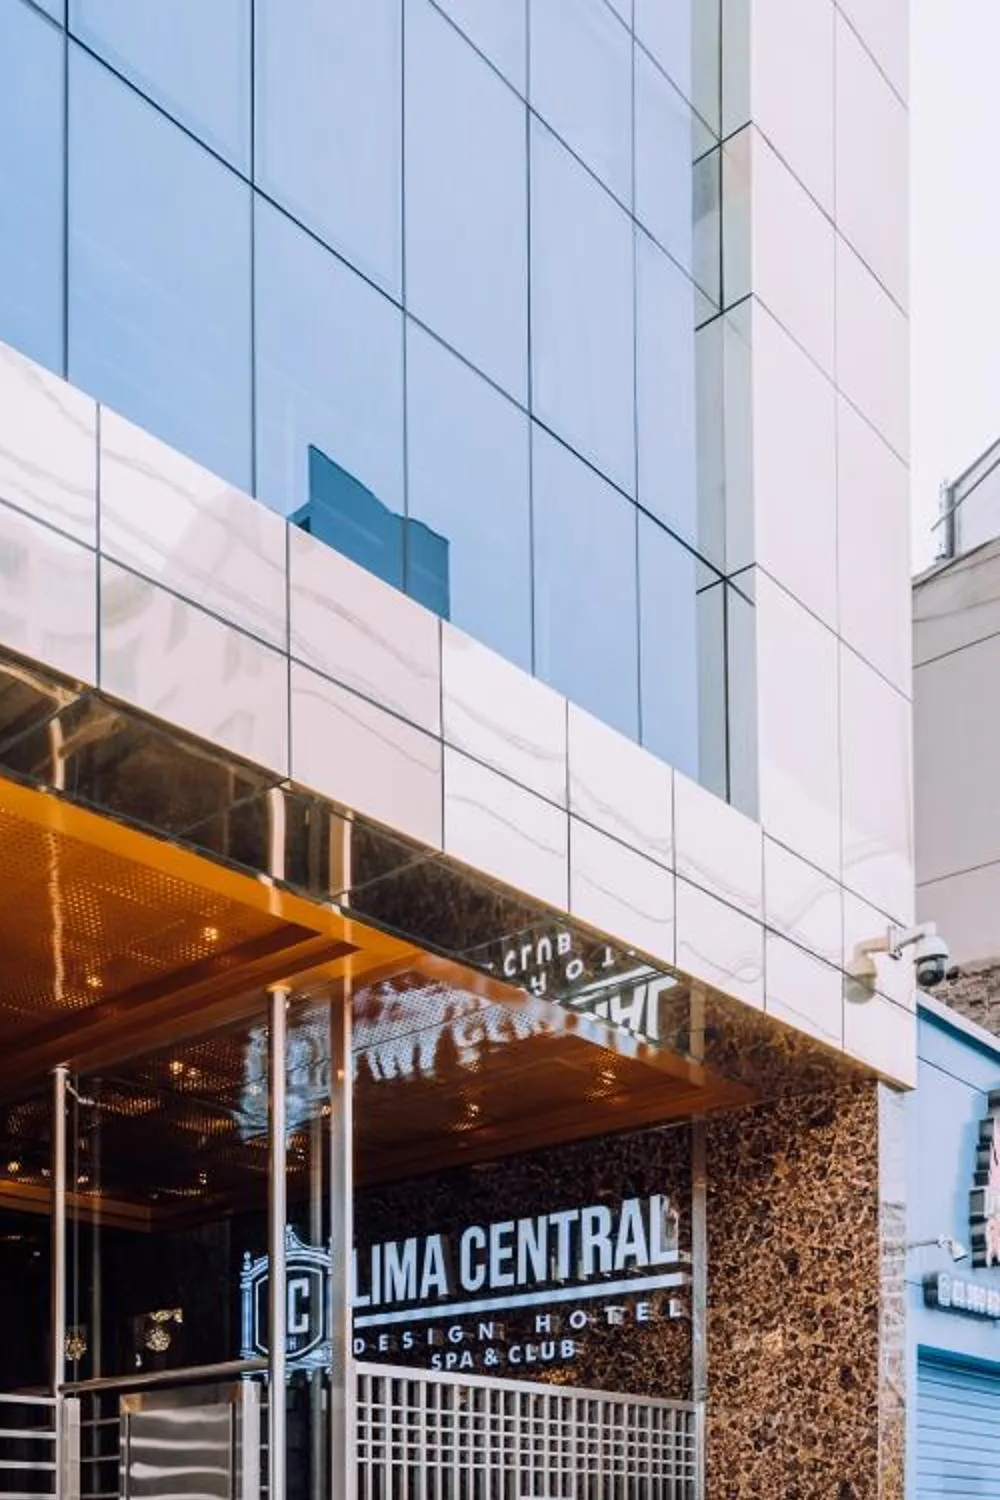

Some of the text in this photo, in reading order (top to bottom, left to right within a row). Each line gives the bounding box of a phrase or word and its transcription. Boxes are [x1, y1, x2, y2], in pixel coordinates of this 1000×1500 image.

[351, 1194, 680, 1308] LIMA CENTRAL
[353, 1299, 681, 1354] DESIGN HOTEL
[431, 1339, 577, 1371] SPA & CLUB
